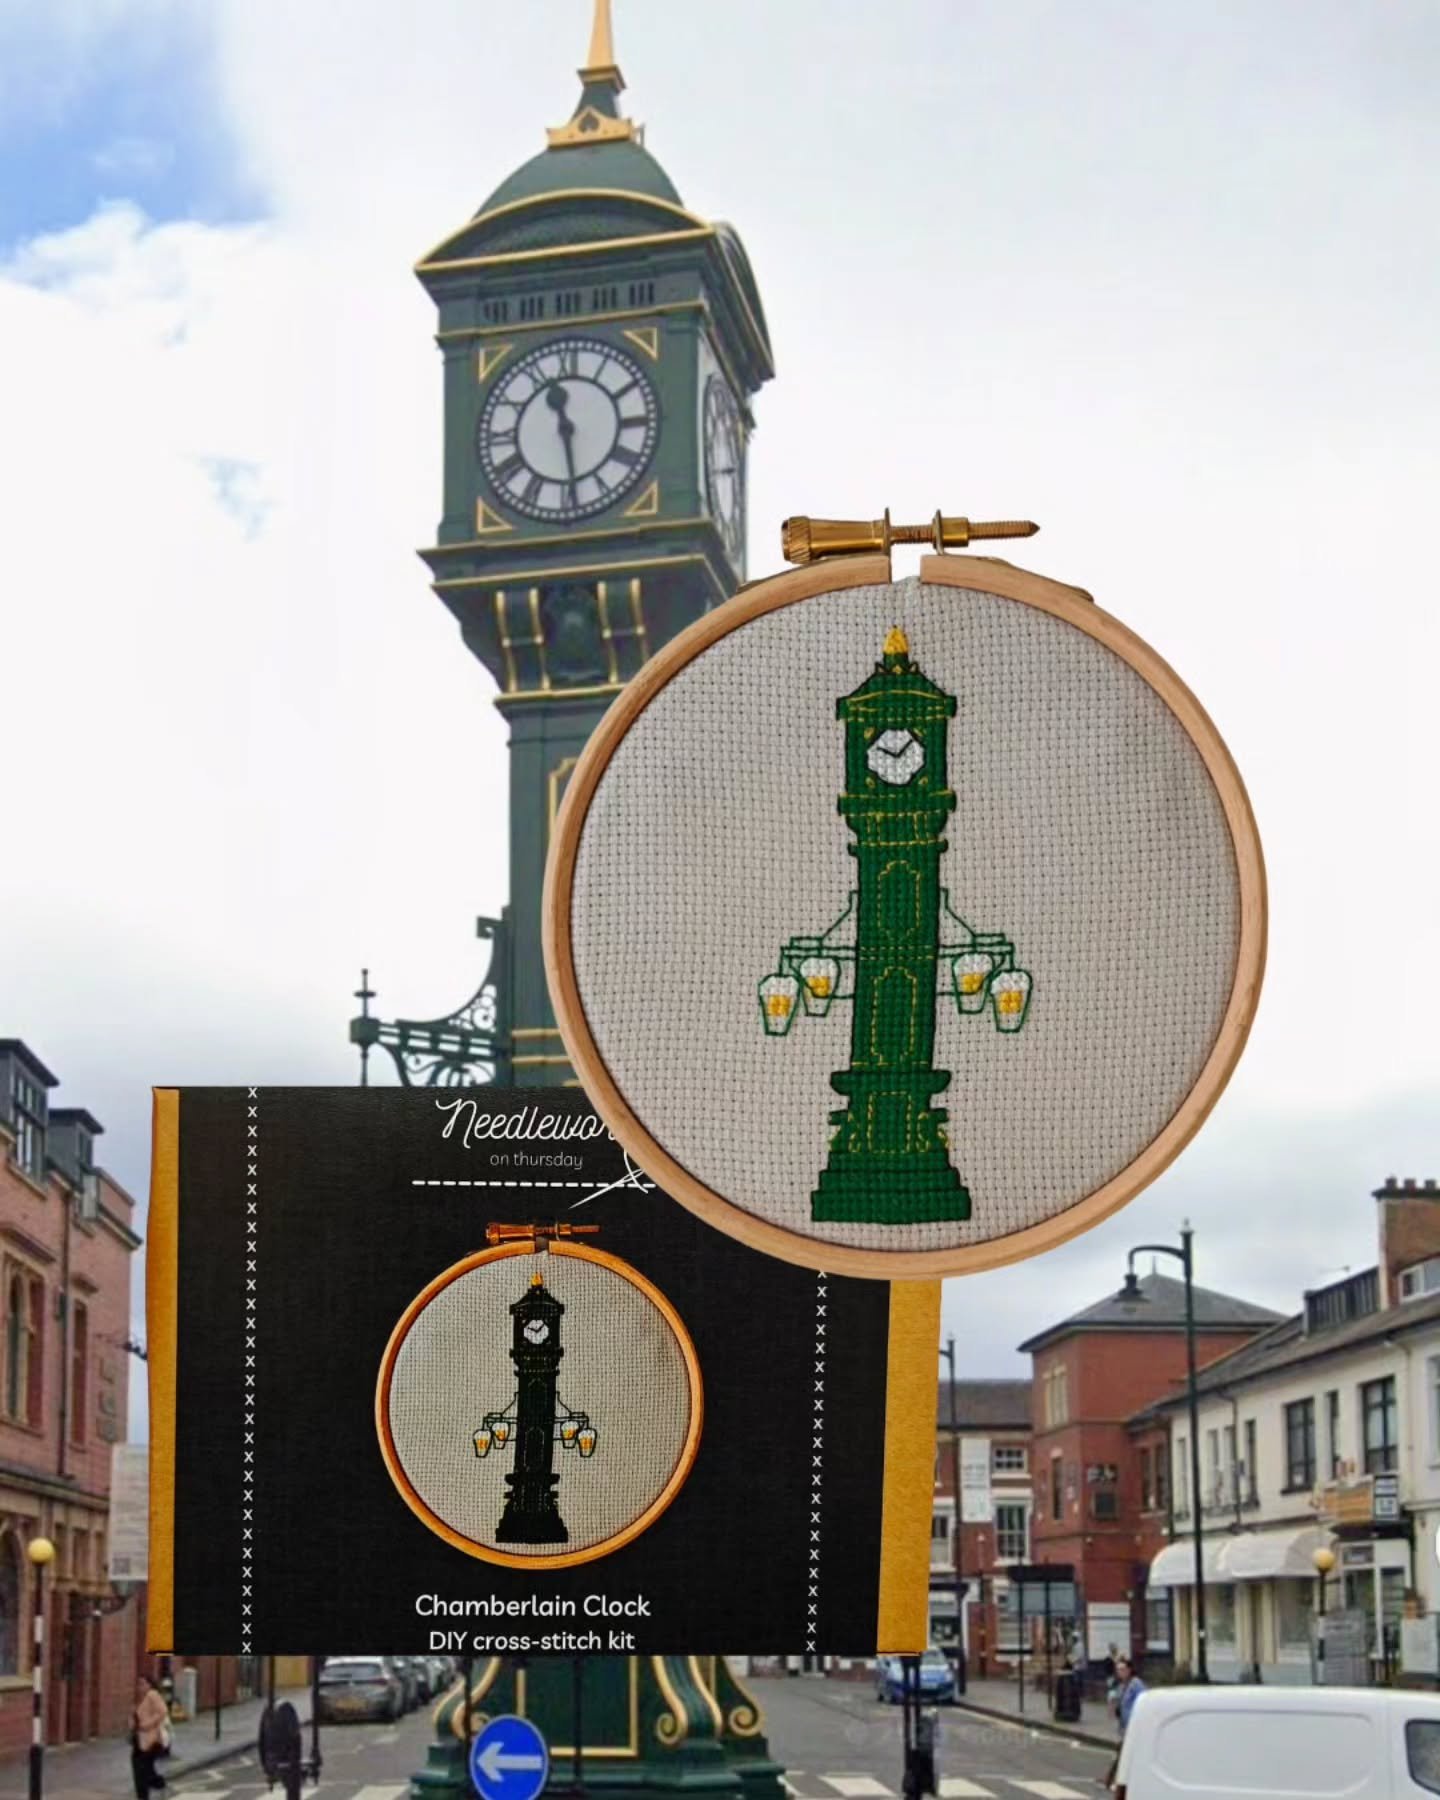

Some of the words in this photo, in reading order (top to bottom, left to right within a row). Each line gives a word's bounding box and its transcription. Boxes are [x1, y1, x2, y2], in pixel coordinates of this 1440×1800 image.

[490, 1154, 509, 1167] on
[513, 1151, 583, 1170] thursday
[415, 1594, 576, 1616] Chamberlain
[583, 1594, 651, 1616] Clock
[429, 1631, 468, 1650] DIY
[472, 1630, 602, 1650] cross-stitch
[608, 1630, 636, 1650] kit
